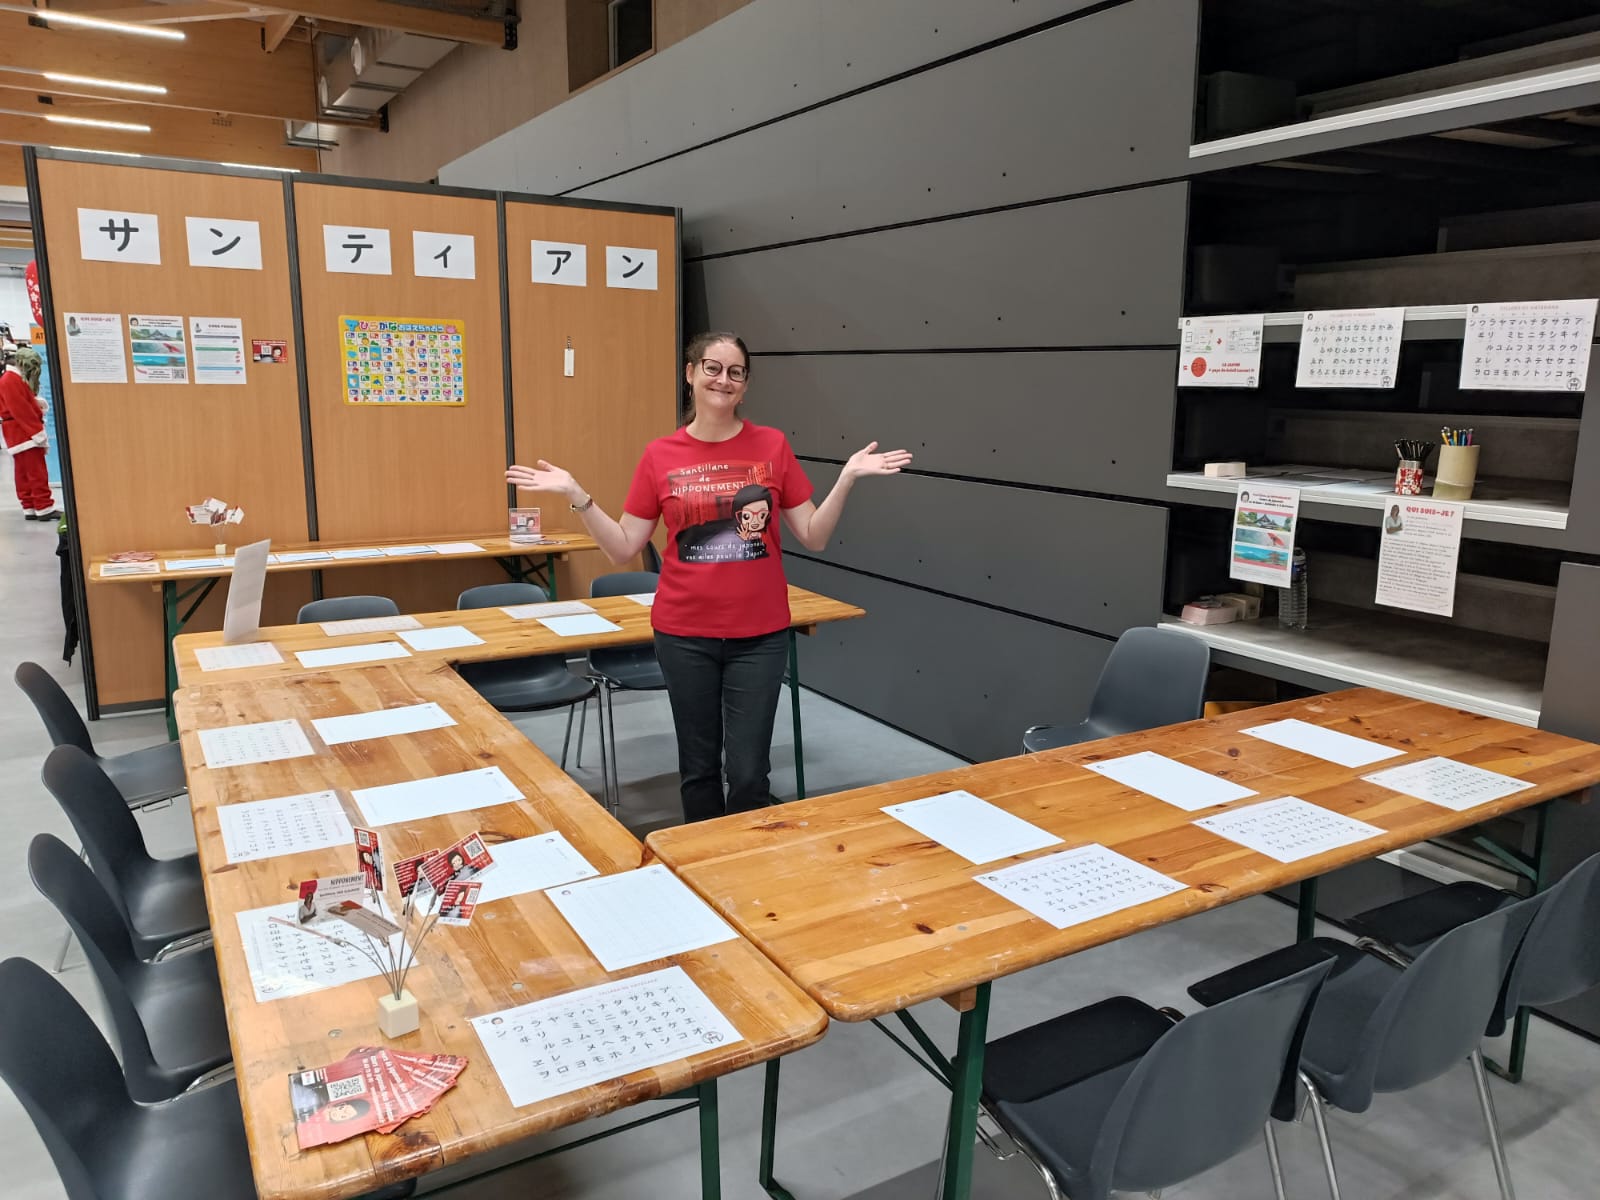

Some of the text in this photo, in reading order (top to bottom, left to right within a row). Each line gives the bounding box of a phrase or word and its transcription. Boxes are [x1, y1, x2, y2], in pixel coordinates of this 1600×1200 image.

[99, 218, 139, 252] サ
[210, 228, 241, 256] ン
[342, 234, 373, 263] テ
[546, 250, 572, 275] ア
[622, 255, 644, 279] ン
[359, 321, 397, 331] ひらがな
[680, 463, 729, 476] Santillane
[672, 481, 746, 496] NIPPONEMENT
[1406, 506, 1419, 514] QUI
